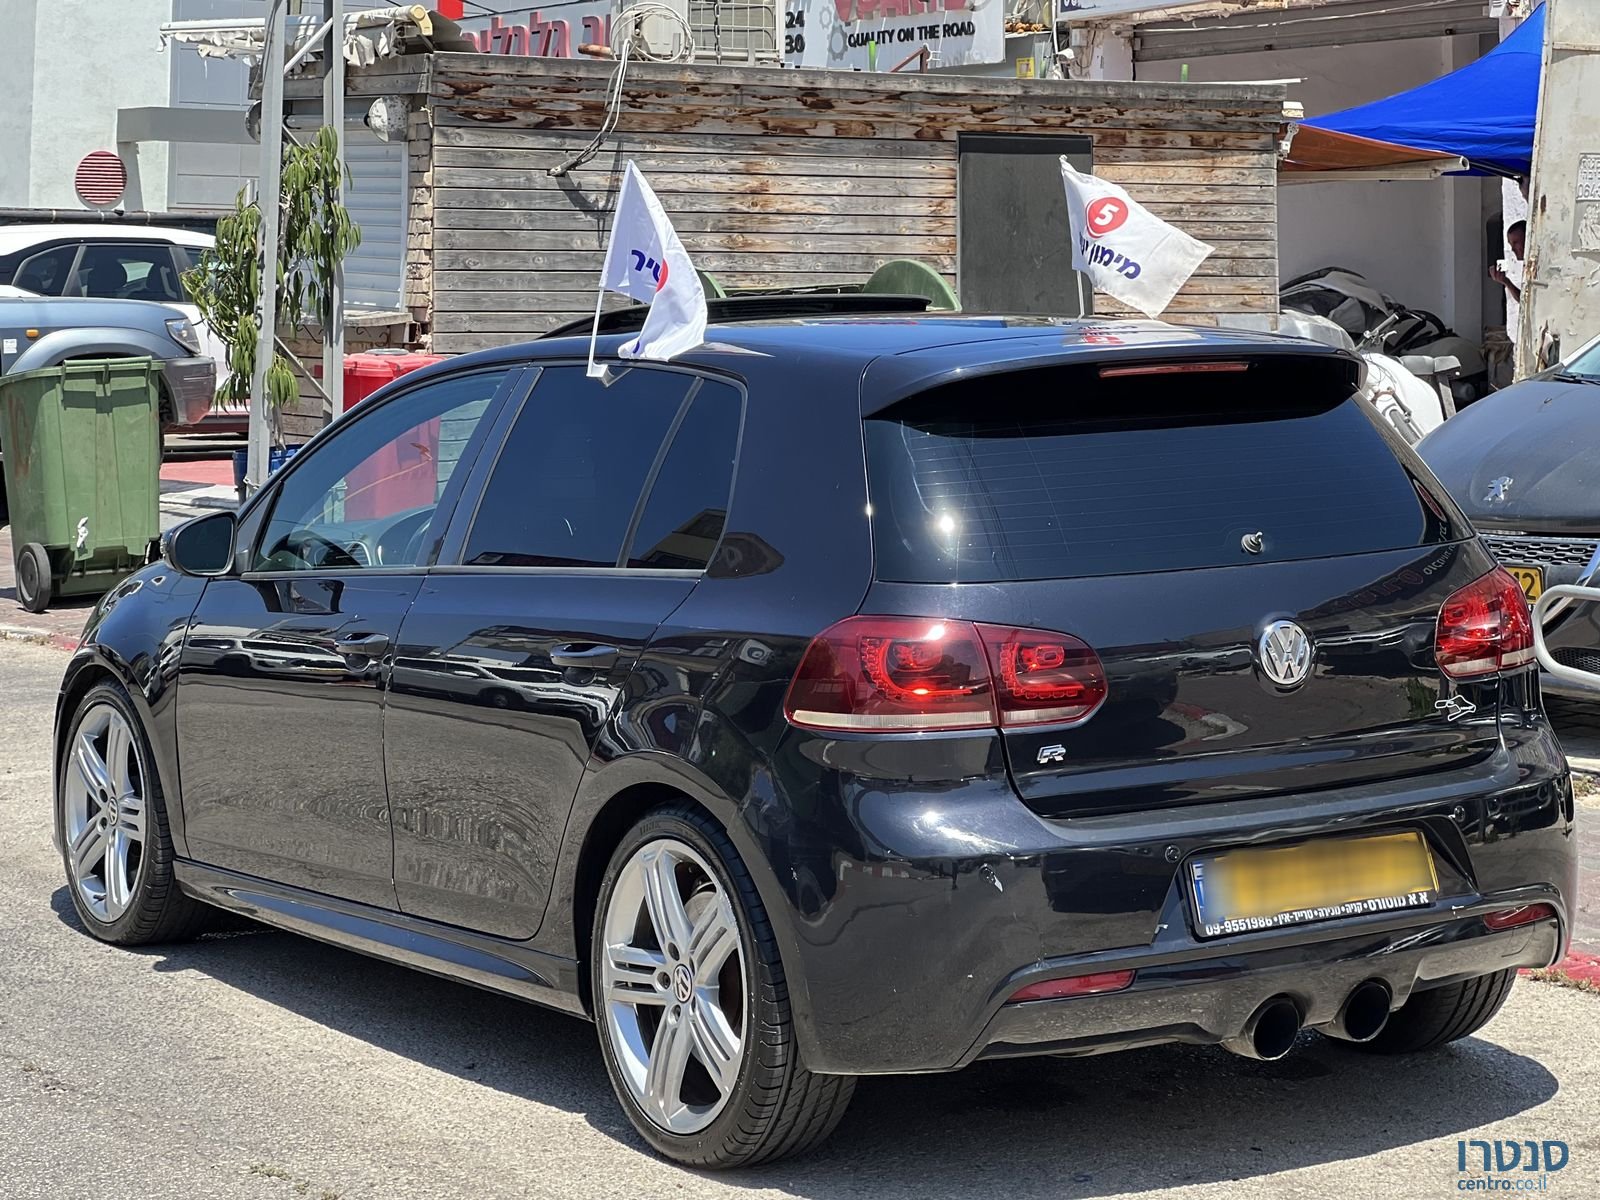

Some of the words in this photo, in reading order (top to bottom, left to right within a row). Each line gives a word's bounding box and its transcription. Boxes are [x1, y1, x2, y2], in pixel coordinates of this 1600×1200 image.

[848, 29, 895, 48] QUALITY
[897, 27, 915, 42] ON
[917, 25, 940, 41] THE
[942, 21, 976, 38] ROAD
[1094, 203, 1120, 226] 5
[1367, 895, 1407, 912] מוטורס
[1407, 893, 1418, 906] א
[1419, 891, 1429, 904] א
[1205, 916, 1273, 936] 09-9551986
